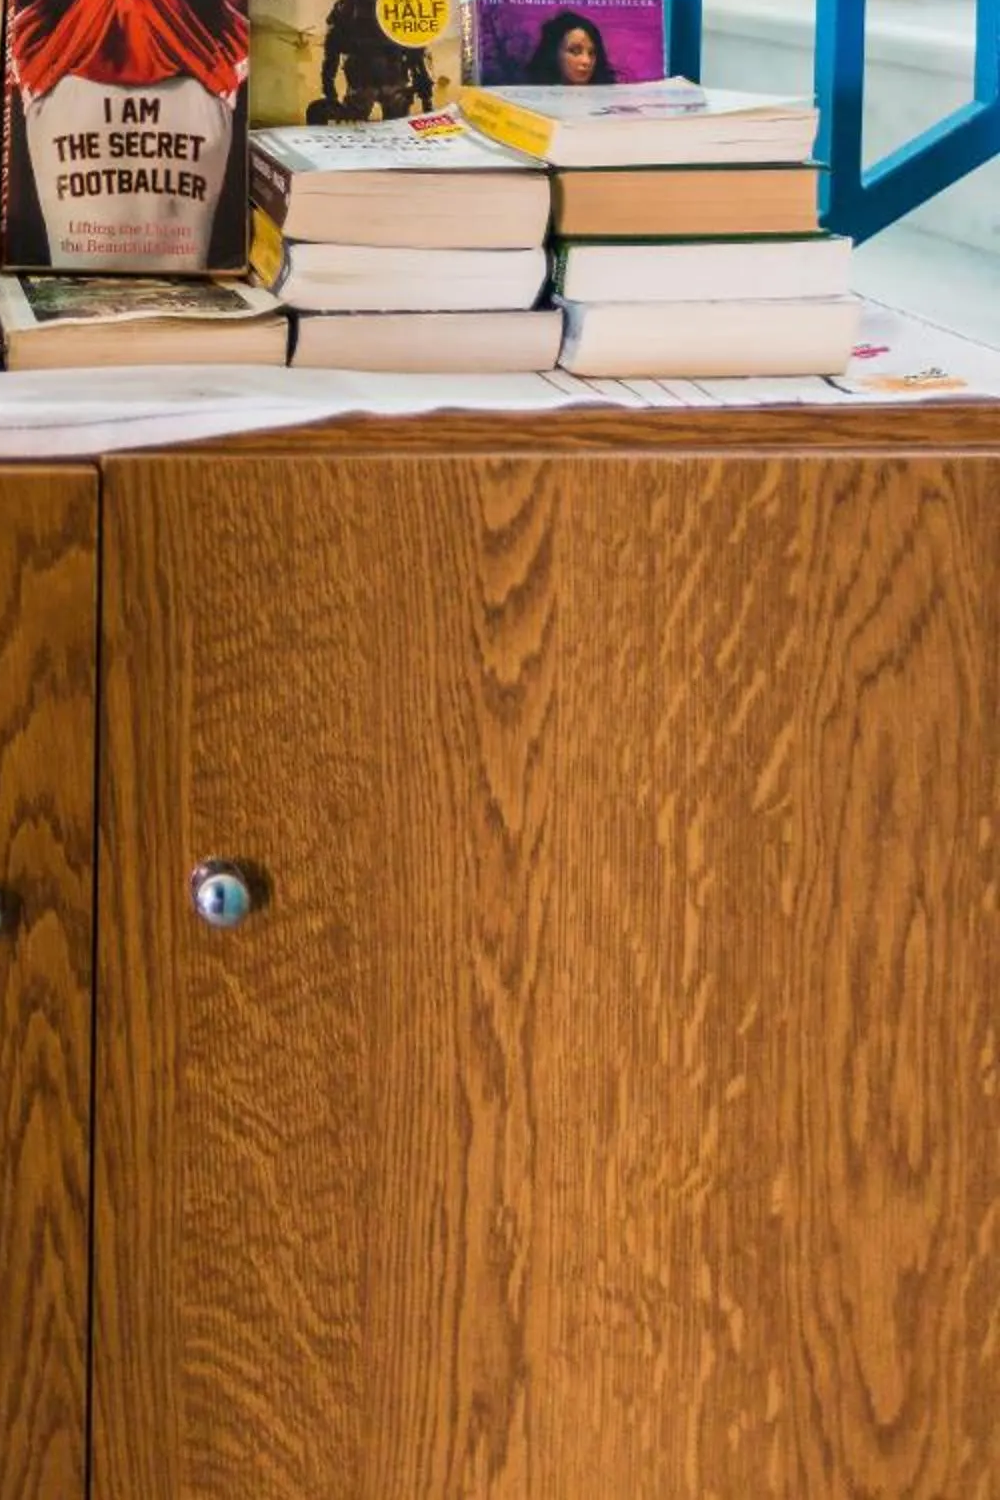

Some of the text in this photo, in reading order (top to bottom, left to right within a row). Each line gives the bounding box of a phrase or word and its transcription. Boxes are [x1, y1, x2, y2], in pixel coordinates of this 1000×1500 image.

[383, 1, 446, 20] HALF
[391, 20, 440, 34] PRICE
[103, 97, 161, 124] I AM
[52, 131, 206, 162] THE SECRET
[56, 167, 208, 201] FOOTBALLER
